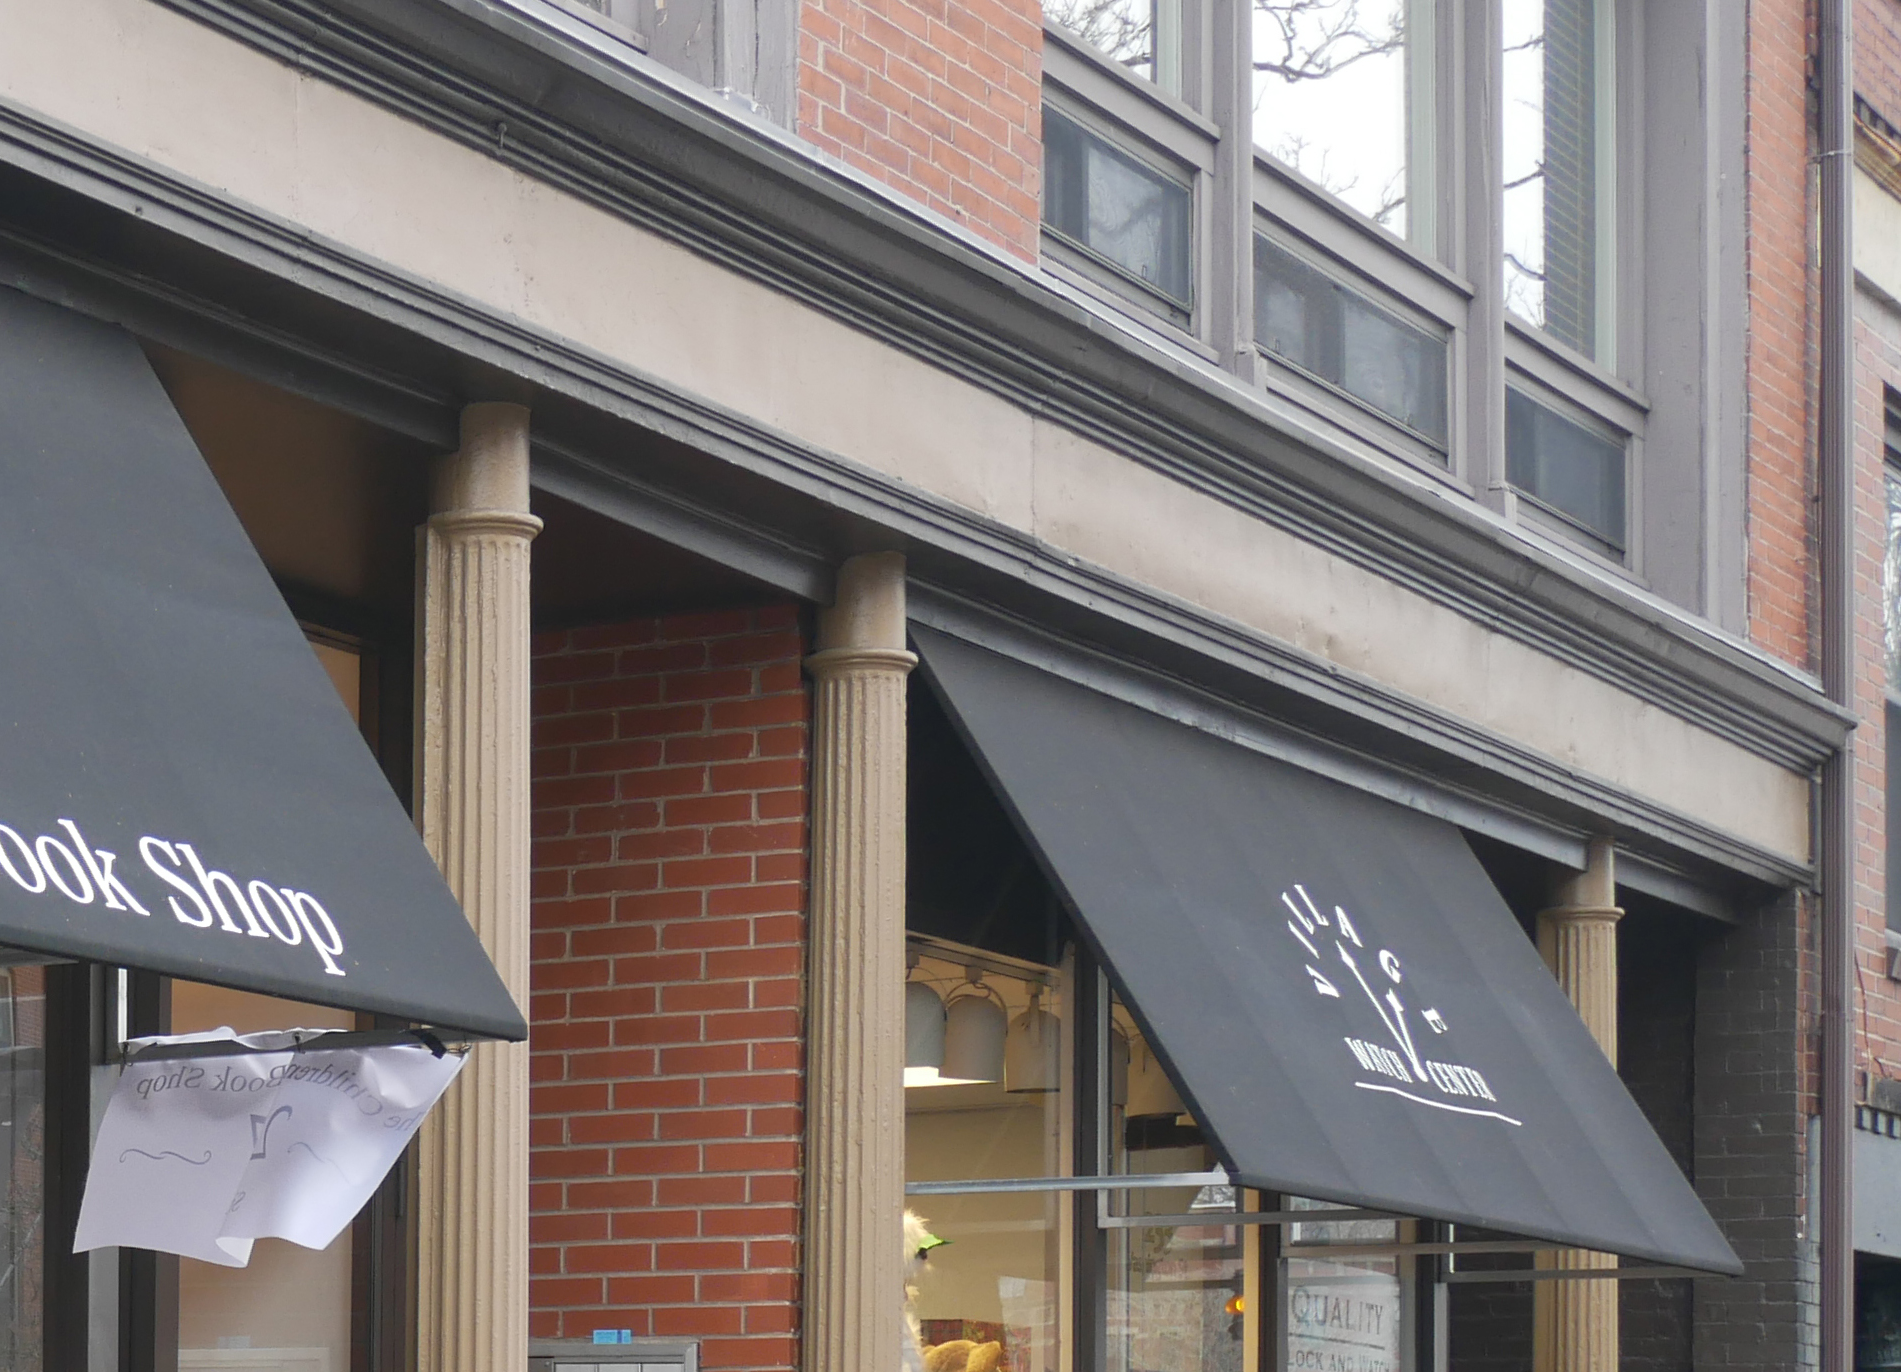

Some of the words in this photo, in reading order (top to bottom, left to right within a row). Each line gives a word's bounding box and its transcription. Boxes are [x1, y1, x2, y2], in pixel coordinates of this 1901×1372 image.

[139, 835, 347, 977] Shop
[1281, 883, 1449, 1035] VILLAGE
[1343, 1036, 1414, 1084] WATCH
[1425, 1059, 1497, 1103] CENTER
[1290, 1285, 1384, 1336] QUALITY
